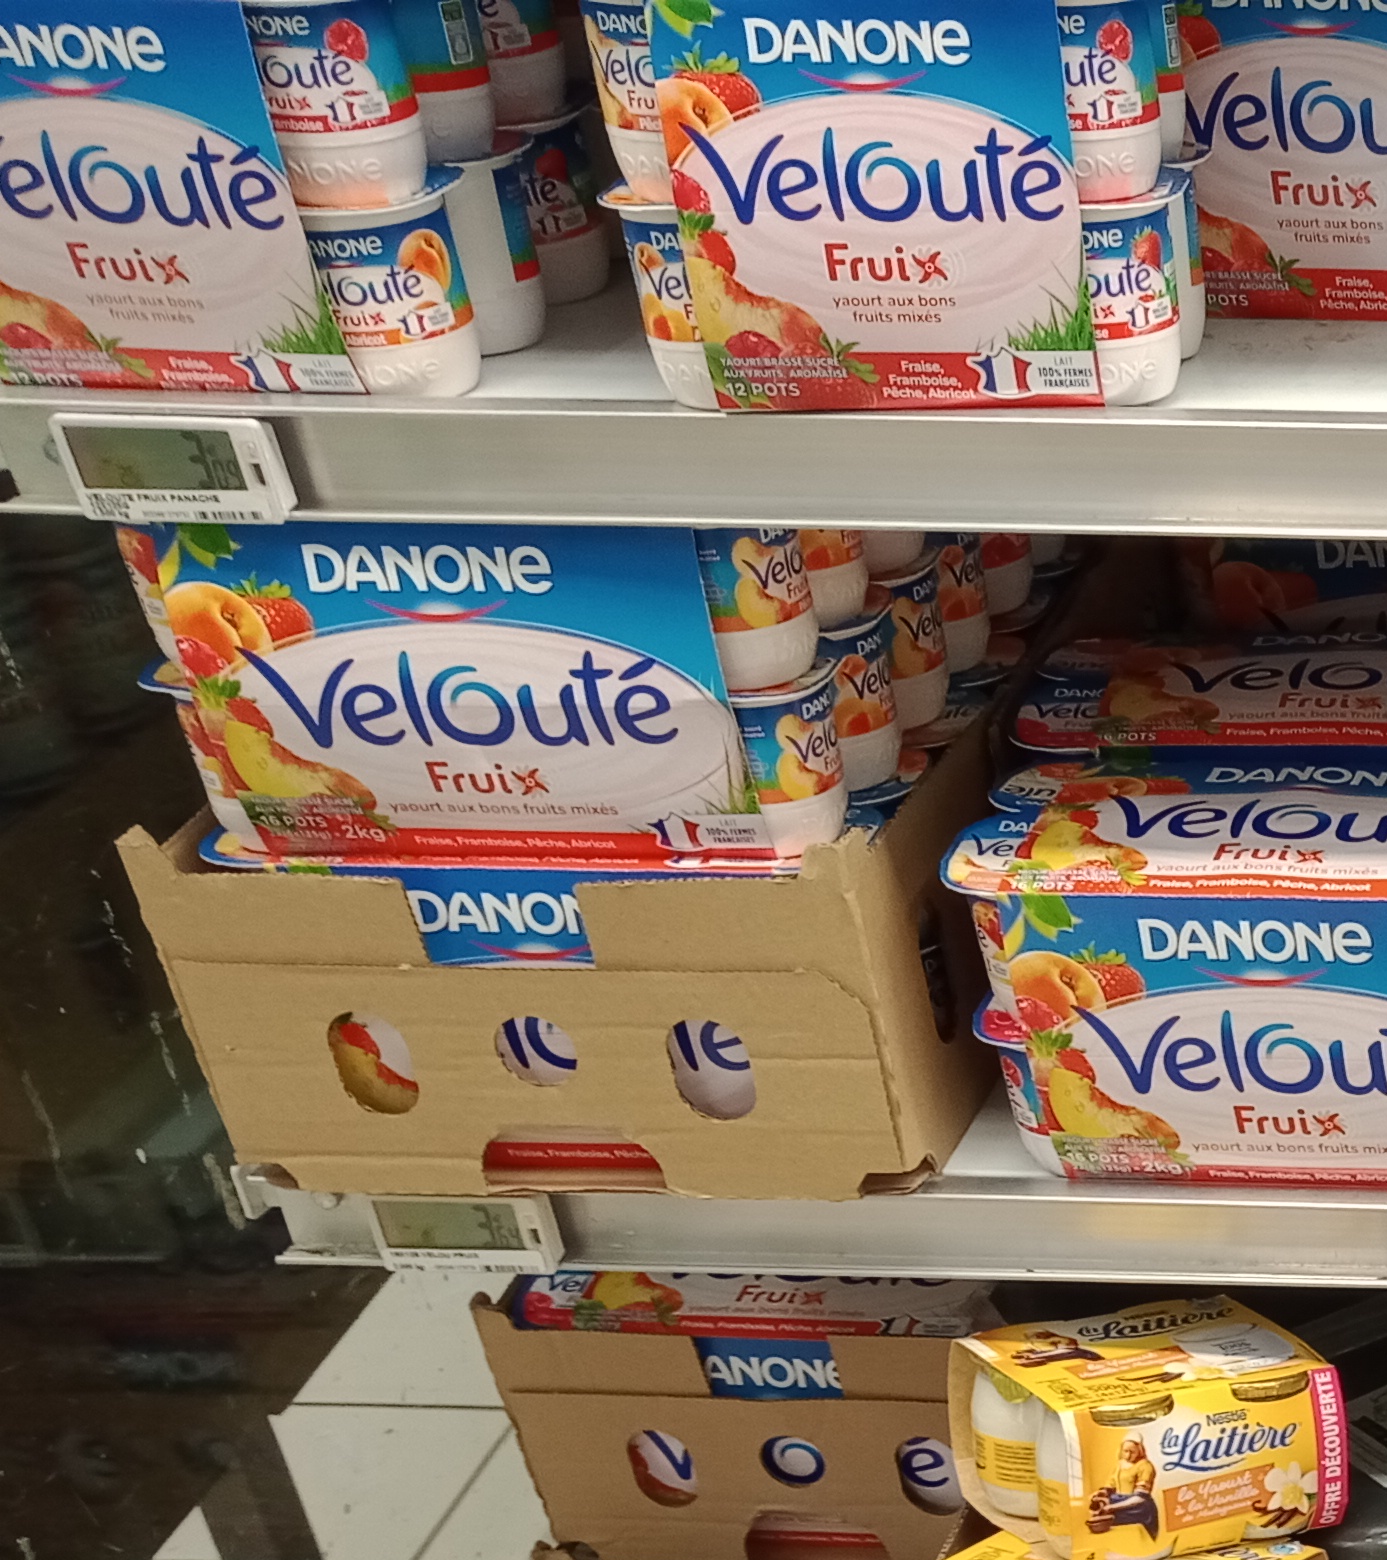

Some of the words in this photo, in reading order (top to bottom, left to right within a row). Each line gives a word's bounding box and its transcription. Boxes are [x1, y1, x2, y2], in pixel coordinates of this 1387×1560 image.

[0, 25, 165, 72] ANONE
[1270, 170, 1378, 209] Fruix
[1277, 219, 1320, 230] yaourt
[1324, 220, 1346, 229] aux
[1351, 220, 1383, 230] bons
[1294, 231, 1328, 243] fruits
[1333, 233, 1370, 244] mixés
[825, 244, 948, 285] Fruix
[1335, 277, 1373, 288] Fraise,
[140, 295, 164, 307] aux
[1207, 294, 1248, 306] POTS
[1325, 288, 1387, 300] Framboise,
[833, 295, 881, 310] yaourt
[886, 295, 911, 308] aux
[917, 294, 956, 308] bons
[109, 310, 148, 322] fruits
[852, 310, 893, 323] fruits
[897, 309, 941, 324] mixés
[900, 361, 944, 375] Fraise,
[1054, 356, 1073, 366] LAIT
[1038, 368, 1062, 377] 100%
[1064, 368, 1092, 377] FERMES
[889, 374, 961, 387] Framboise,
[726, 383, 746, 396] 12
[751, 383, 799, 397] POTS
[882, 387, 927, 400] Pêche,
[929, 387, 976, 400] Abricot
[425, 761, 550, 795] Fruix
[391, 802, 444, 815] yaourt
[449, 803, 475, 814] aux
[479, 802, 520, 815] bons
[524, 802, 567, 815] fruits
[572, 802, 618, 816] mixés
[282, 815, 327, 829] POTS
[1213, 843, 1323, 863] Fruix
[1321, 882, 1371, 893] Abricot
[1234, 1106, 1346, 1136] Fruix
[1312, 1371, 1341, 1478] DÉCOUVERTE
[1320, 1480, 1343, 1526] OFFRE
